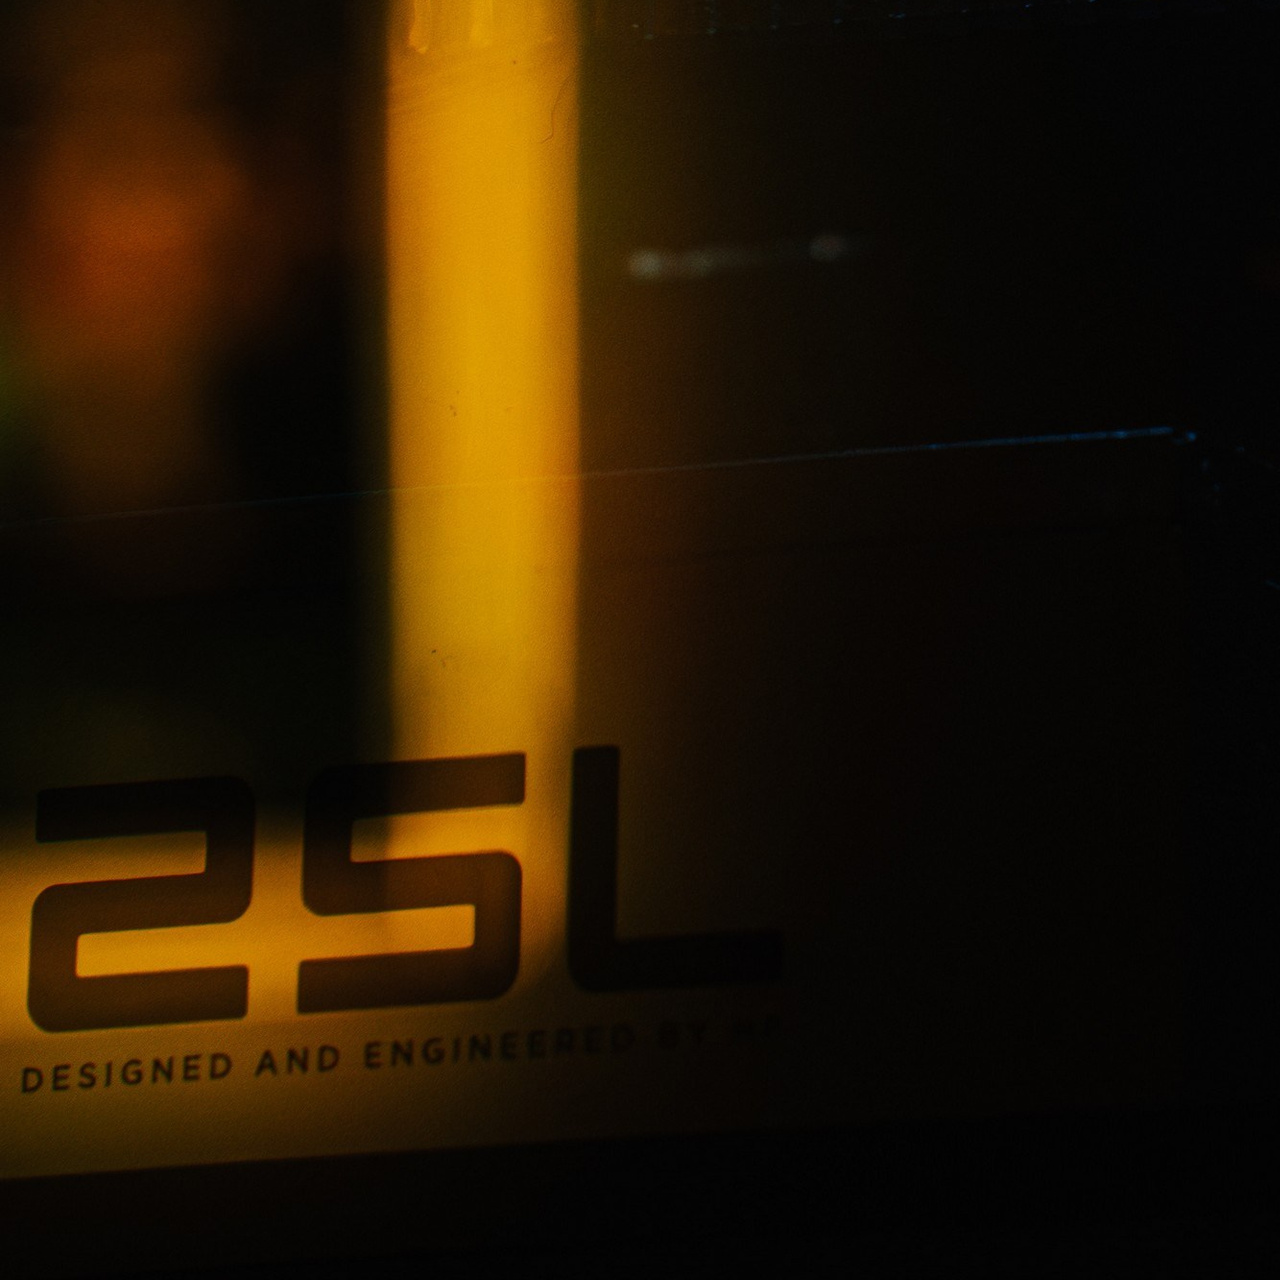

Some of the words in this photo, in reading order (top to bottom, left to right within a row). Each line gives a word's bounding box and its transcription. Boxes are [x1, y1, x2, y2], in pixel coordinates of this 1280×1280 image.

[21, 1052, 233, 1093] DESIGNED
[255, 1044, 341, 1077] AND
[363, 1022, 635, 1070] ENGINEERED
